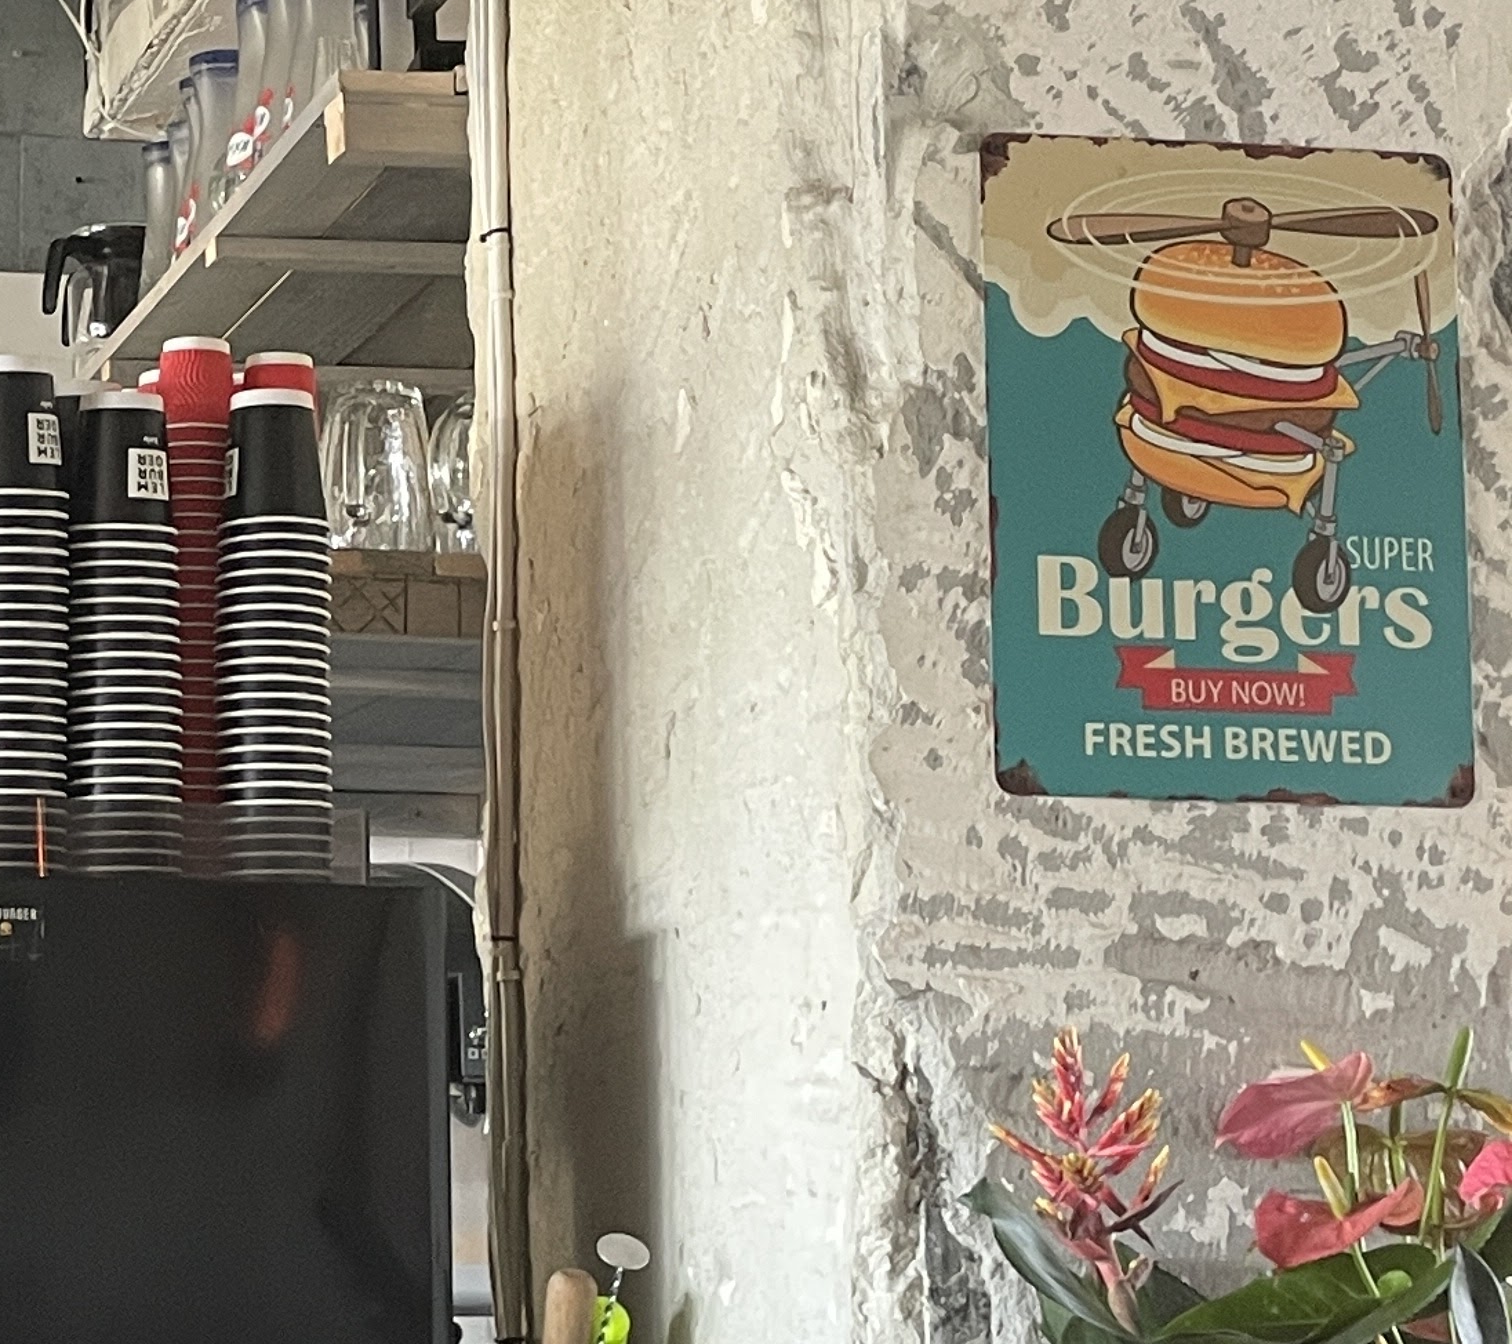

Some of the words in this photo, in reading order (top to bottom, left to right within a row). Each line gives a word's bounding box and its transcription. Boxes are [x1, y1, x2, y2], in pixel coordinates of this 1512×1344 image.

[1346, 536, 1434, 573] SUPER
[1036, 553, 1434, 664] Burgers
[1169, 677, 1223, 705] BUY
[1230, 680, 1306, 708] NOW!
[1083, 722, 1212, 759] FRESH
[1224, 724, 1392, 766] BREWED
